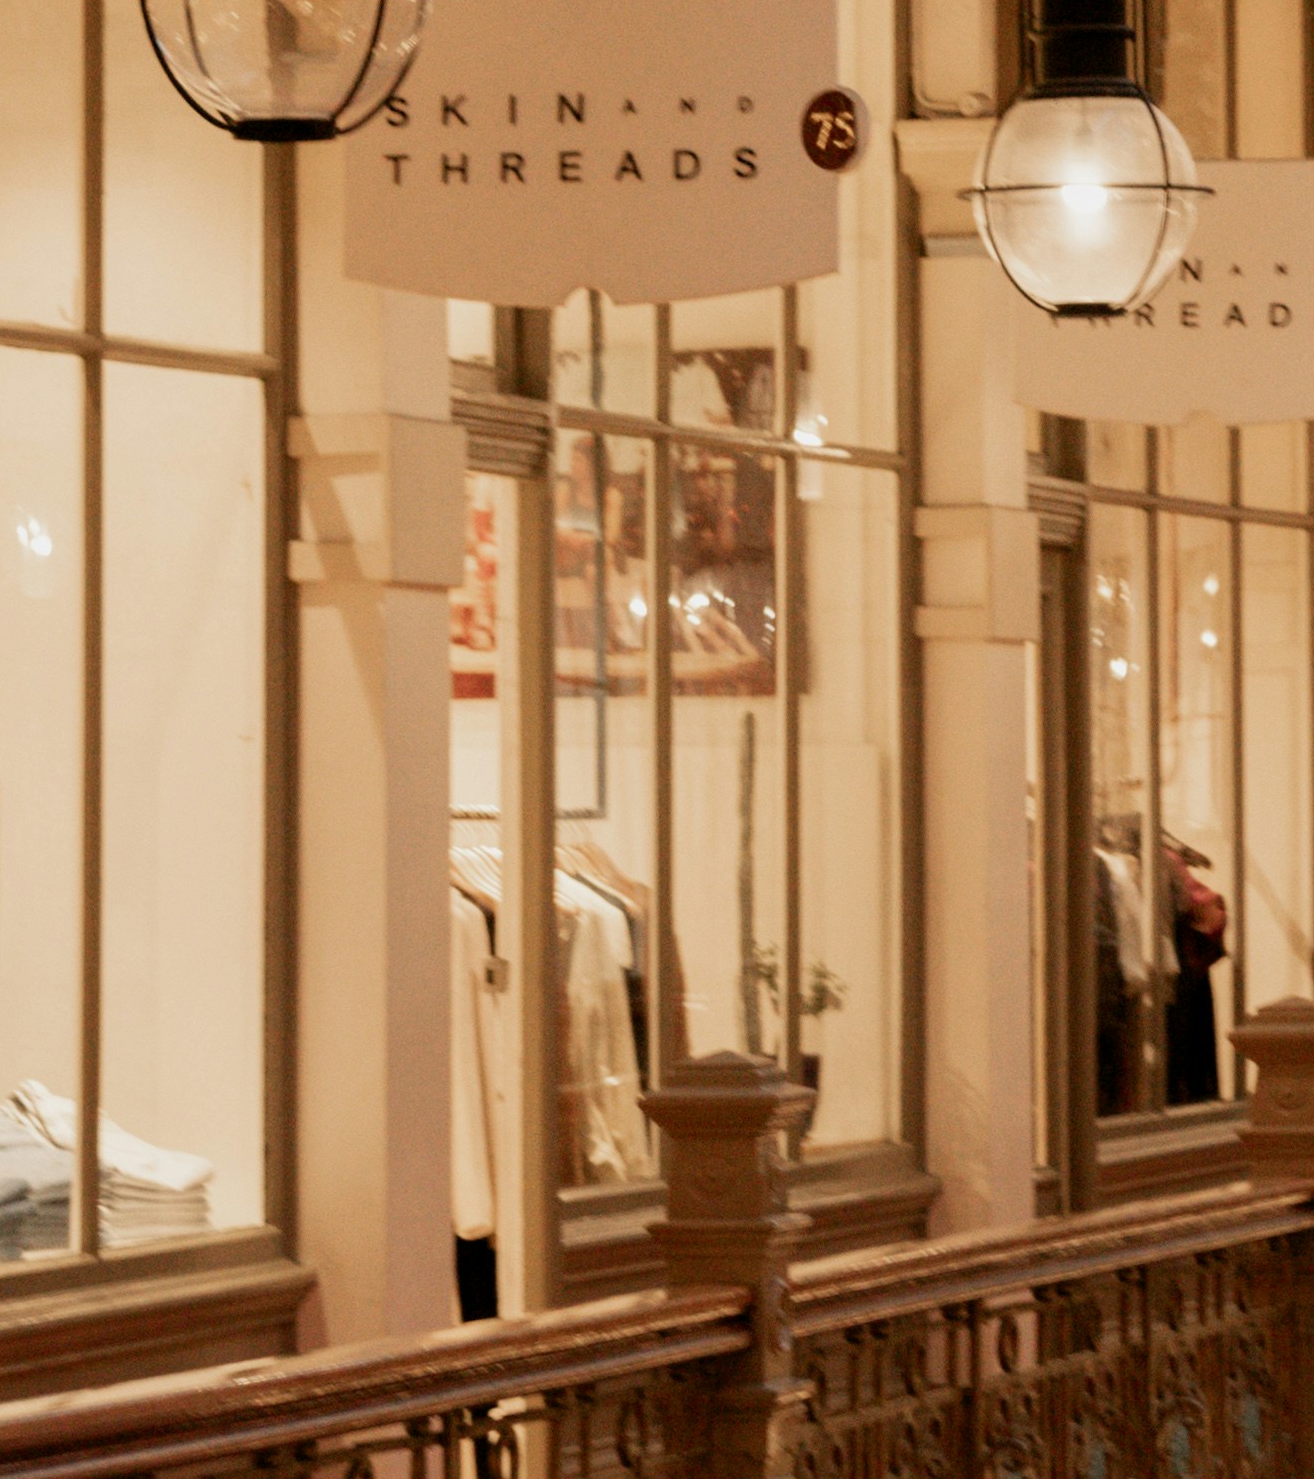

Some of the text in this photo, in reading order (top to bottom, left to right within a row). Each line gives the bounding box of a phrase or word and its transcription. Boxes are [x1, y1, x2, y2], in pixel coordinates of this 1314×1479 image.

[386, 92, 755, 128] SKIN AND
[809, 111, 855, 151] 75
[383, 147, 759, 185] THREADS
